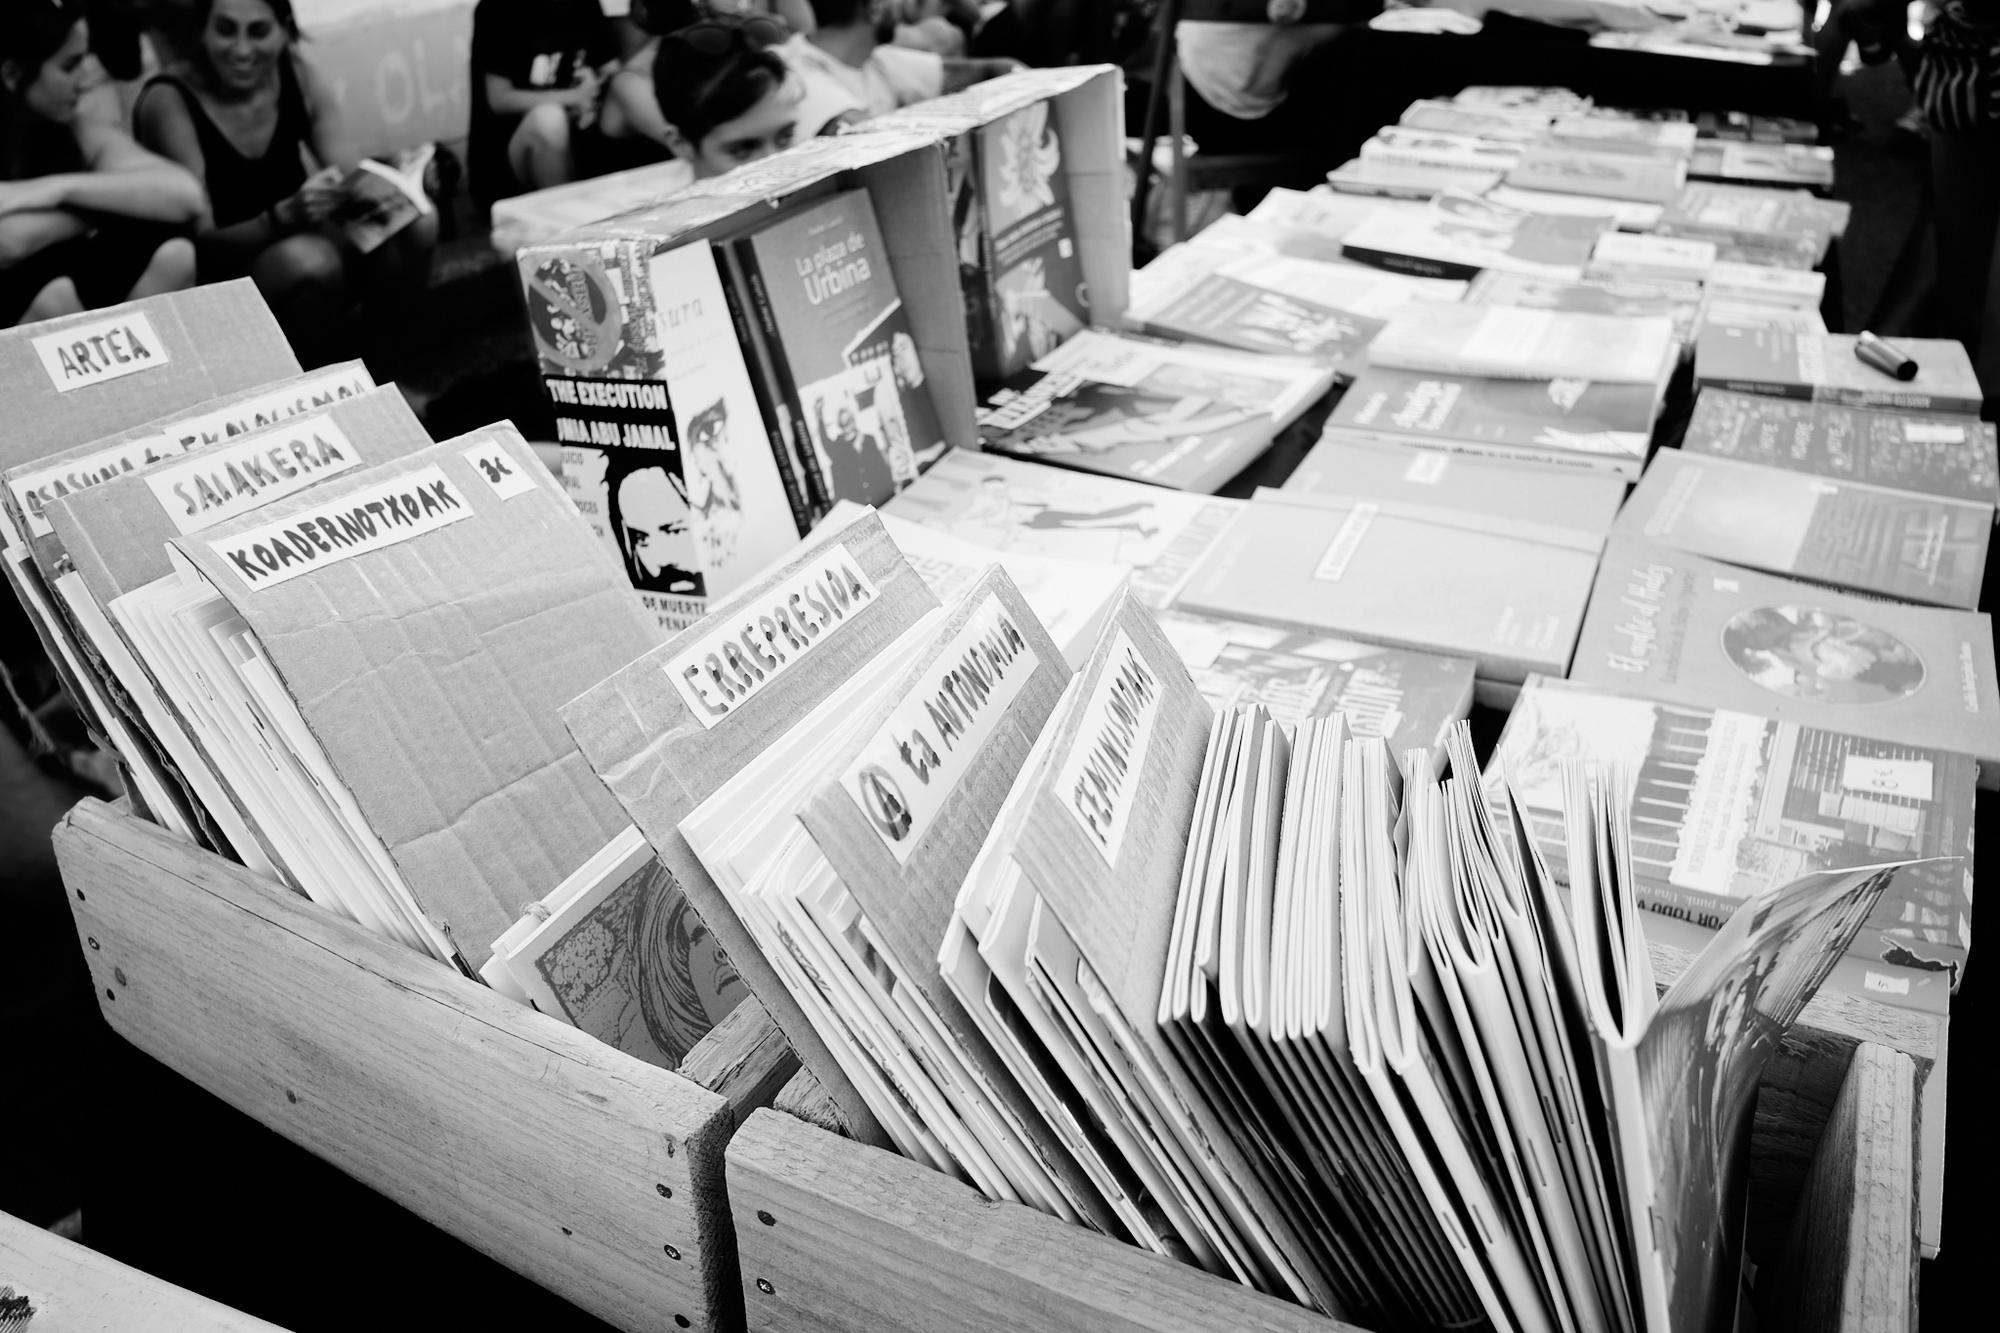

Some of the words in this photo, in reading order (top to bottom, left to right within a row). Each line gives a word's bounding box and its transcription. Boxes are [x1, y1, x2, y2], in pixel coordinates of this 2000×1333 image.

[813, 241, 847, 272] plaza
[847, 231, 866, 252] de
[803, 257, 871, 305] Urbina
[57, 326, 151, 379] ARTEA
[546, 379, 578, 404] THE
[576, 381, 668, 410] EXECUTION
[590, 420, 621, 446] ABU
[623, 423, 676, 450] JAMAL
[173, 433, 344, 517] SAIAKERA
[226, 479, 461, 581] KOADERNOTXOAK
[682, 563, 871, 717] ERREPRESIOA
[890, 728, 942, 785] ta
[1074, 646, 1154, 846] FEMINISMOAK
[1651, 902, 1694, 924] TODO
